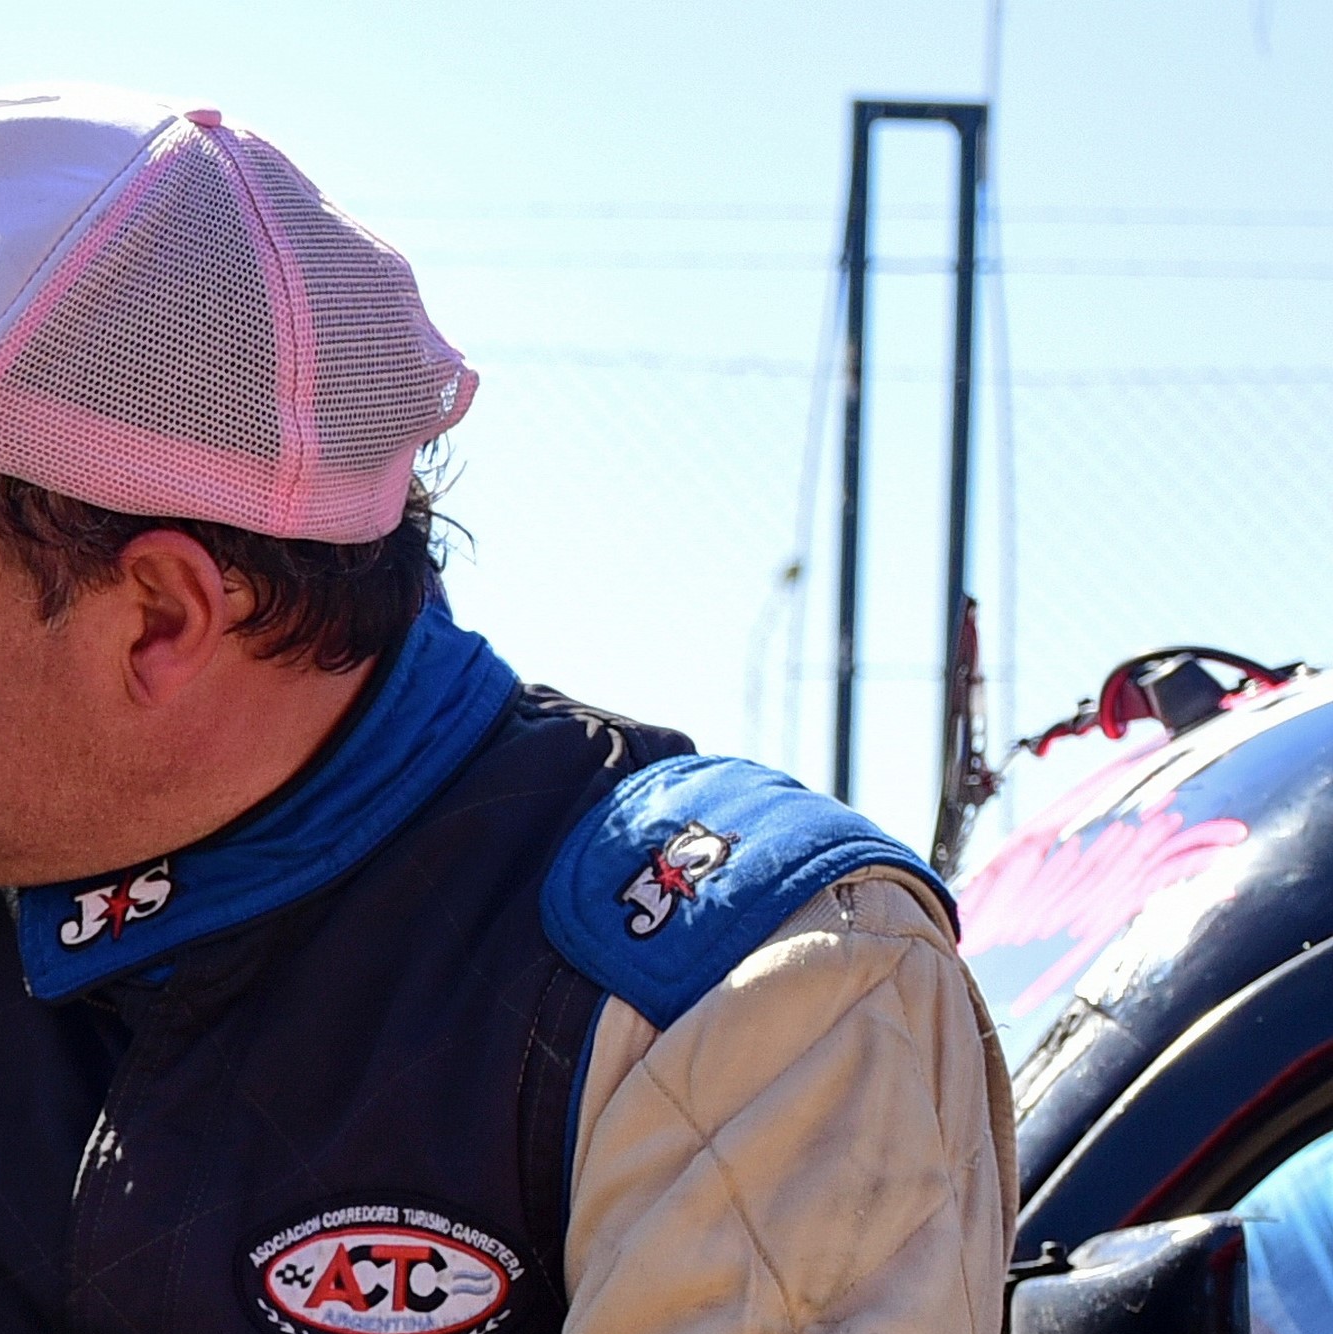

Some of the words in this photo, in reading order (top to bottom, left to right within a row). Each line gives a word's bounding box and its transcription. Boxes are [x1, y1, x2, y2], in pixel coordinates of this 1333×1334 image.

[248, 1215, 322, 1269] ASOCIACION
[322, 1205, 400, 1228] CORREDORES
[403, 1208, 451, 1235] TURISMO
[451, 1222, 525, 1281] CARRETERA
[303, 1242, 449, 1313] ACTC
